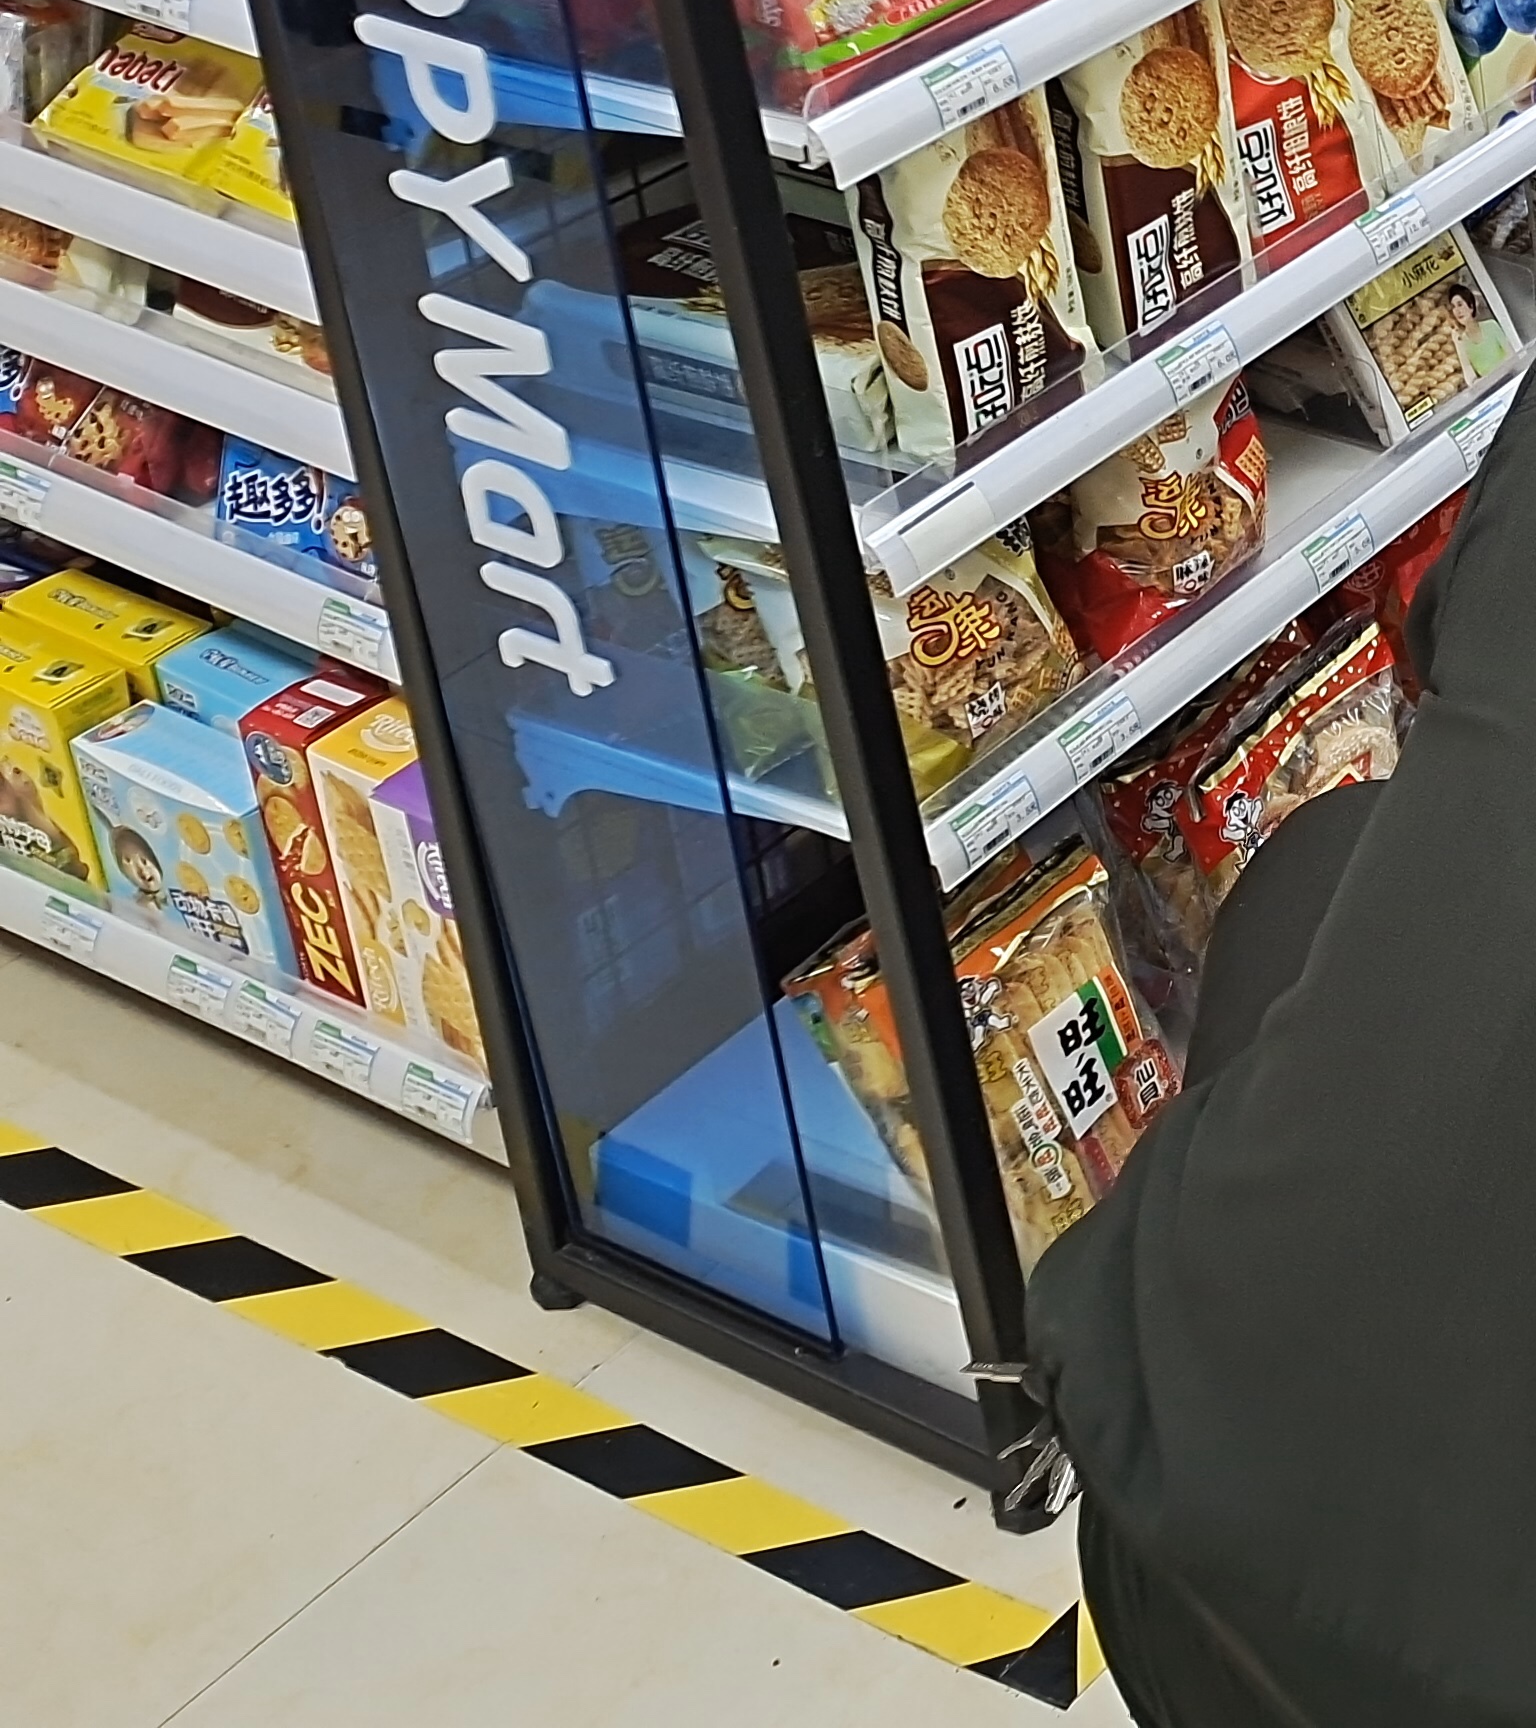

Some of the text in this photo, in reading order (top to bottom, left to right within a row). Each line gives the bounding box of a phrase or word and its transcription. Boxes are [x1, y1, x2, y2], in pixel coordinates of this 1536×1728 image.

[1237, 125, 1289, 221] 好吃点
[1135, 225, 1176, 326] 好吃点
[1399, 255, 1442, 291] 小麻花
[974, 340, 1012, 429] 好吃点
[223, 468, 329, 532] 趣多多!
[417, 290, 616, 698] Mart
[1056, 996, 1107, 1119] 旺旺
